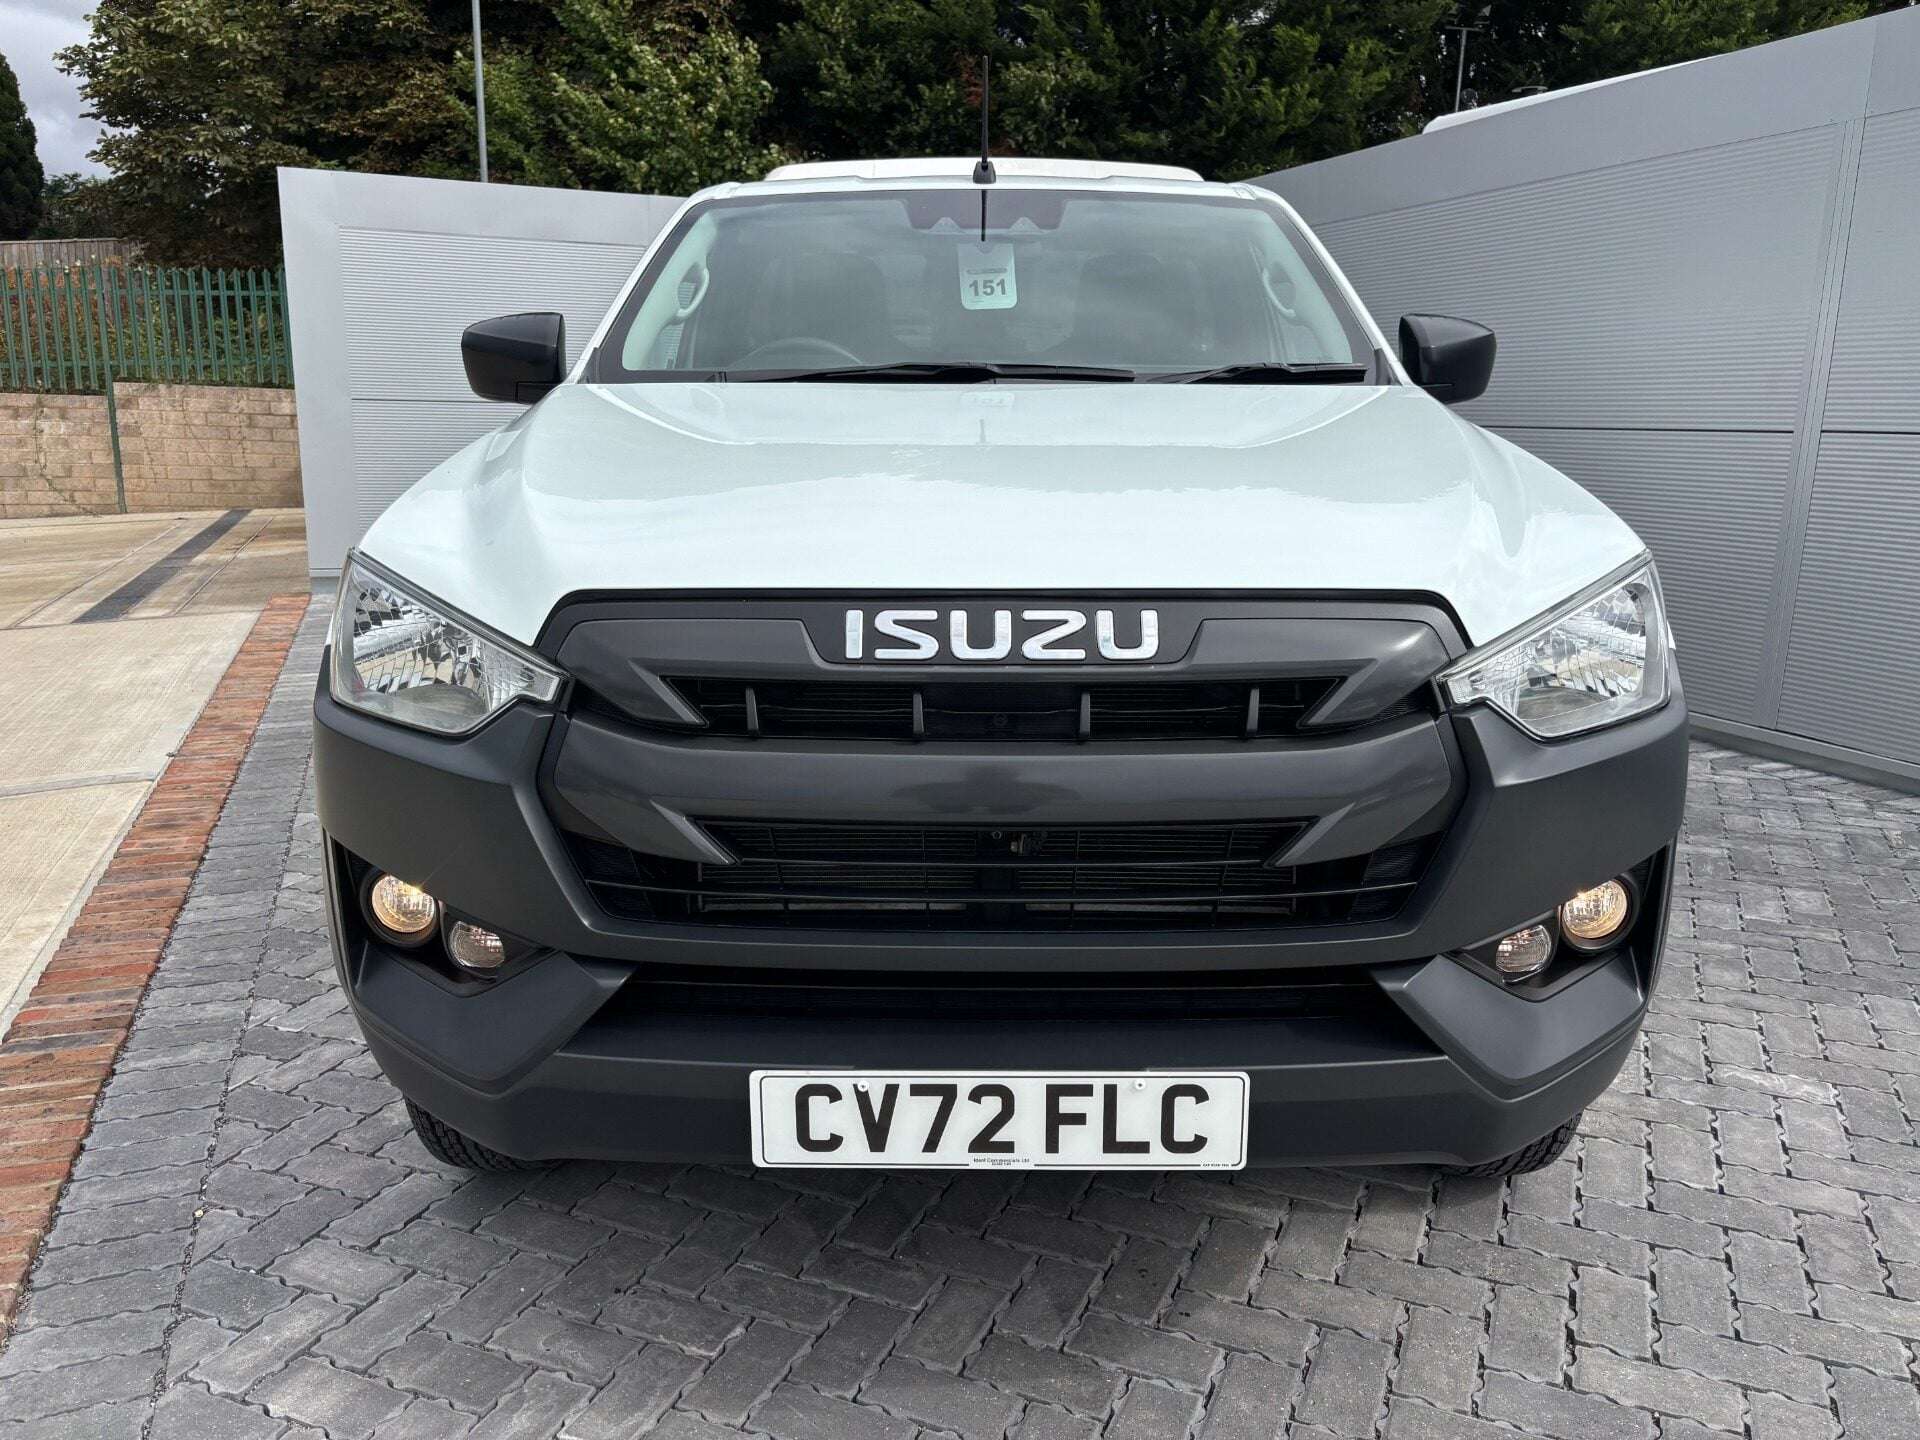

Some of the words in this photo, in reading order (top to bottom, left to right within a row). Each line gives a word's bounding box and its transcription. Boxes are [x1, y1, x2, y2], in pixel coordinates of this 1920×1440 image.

[969, 279, 1006, 296] 151
[846, 610, 1158, 659] ISUZU
[795, 1083, 1015, 1153] CV72
[1045, 1084, 1210, 1154] FLC
